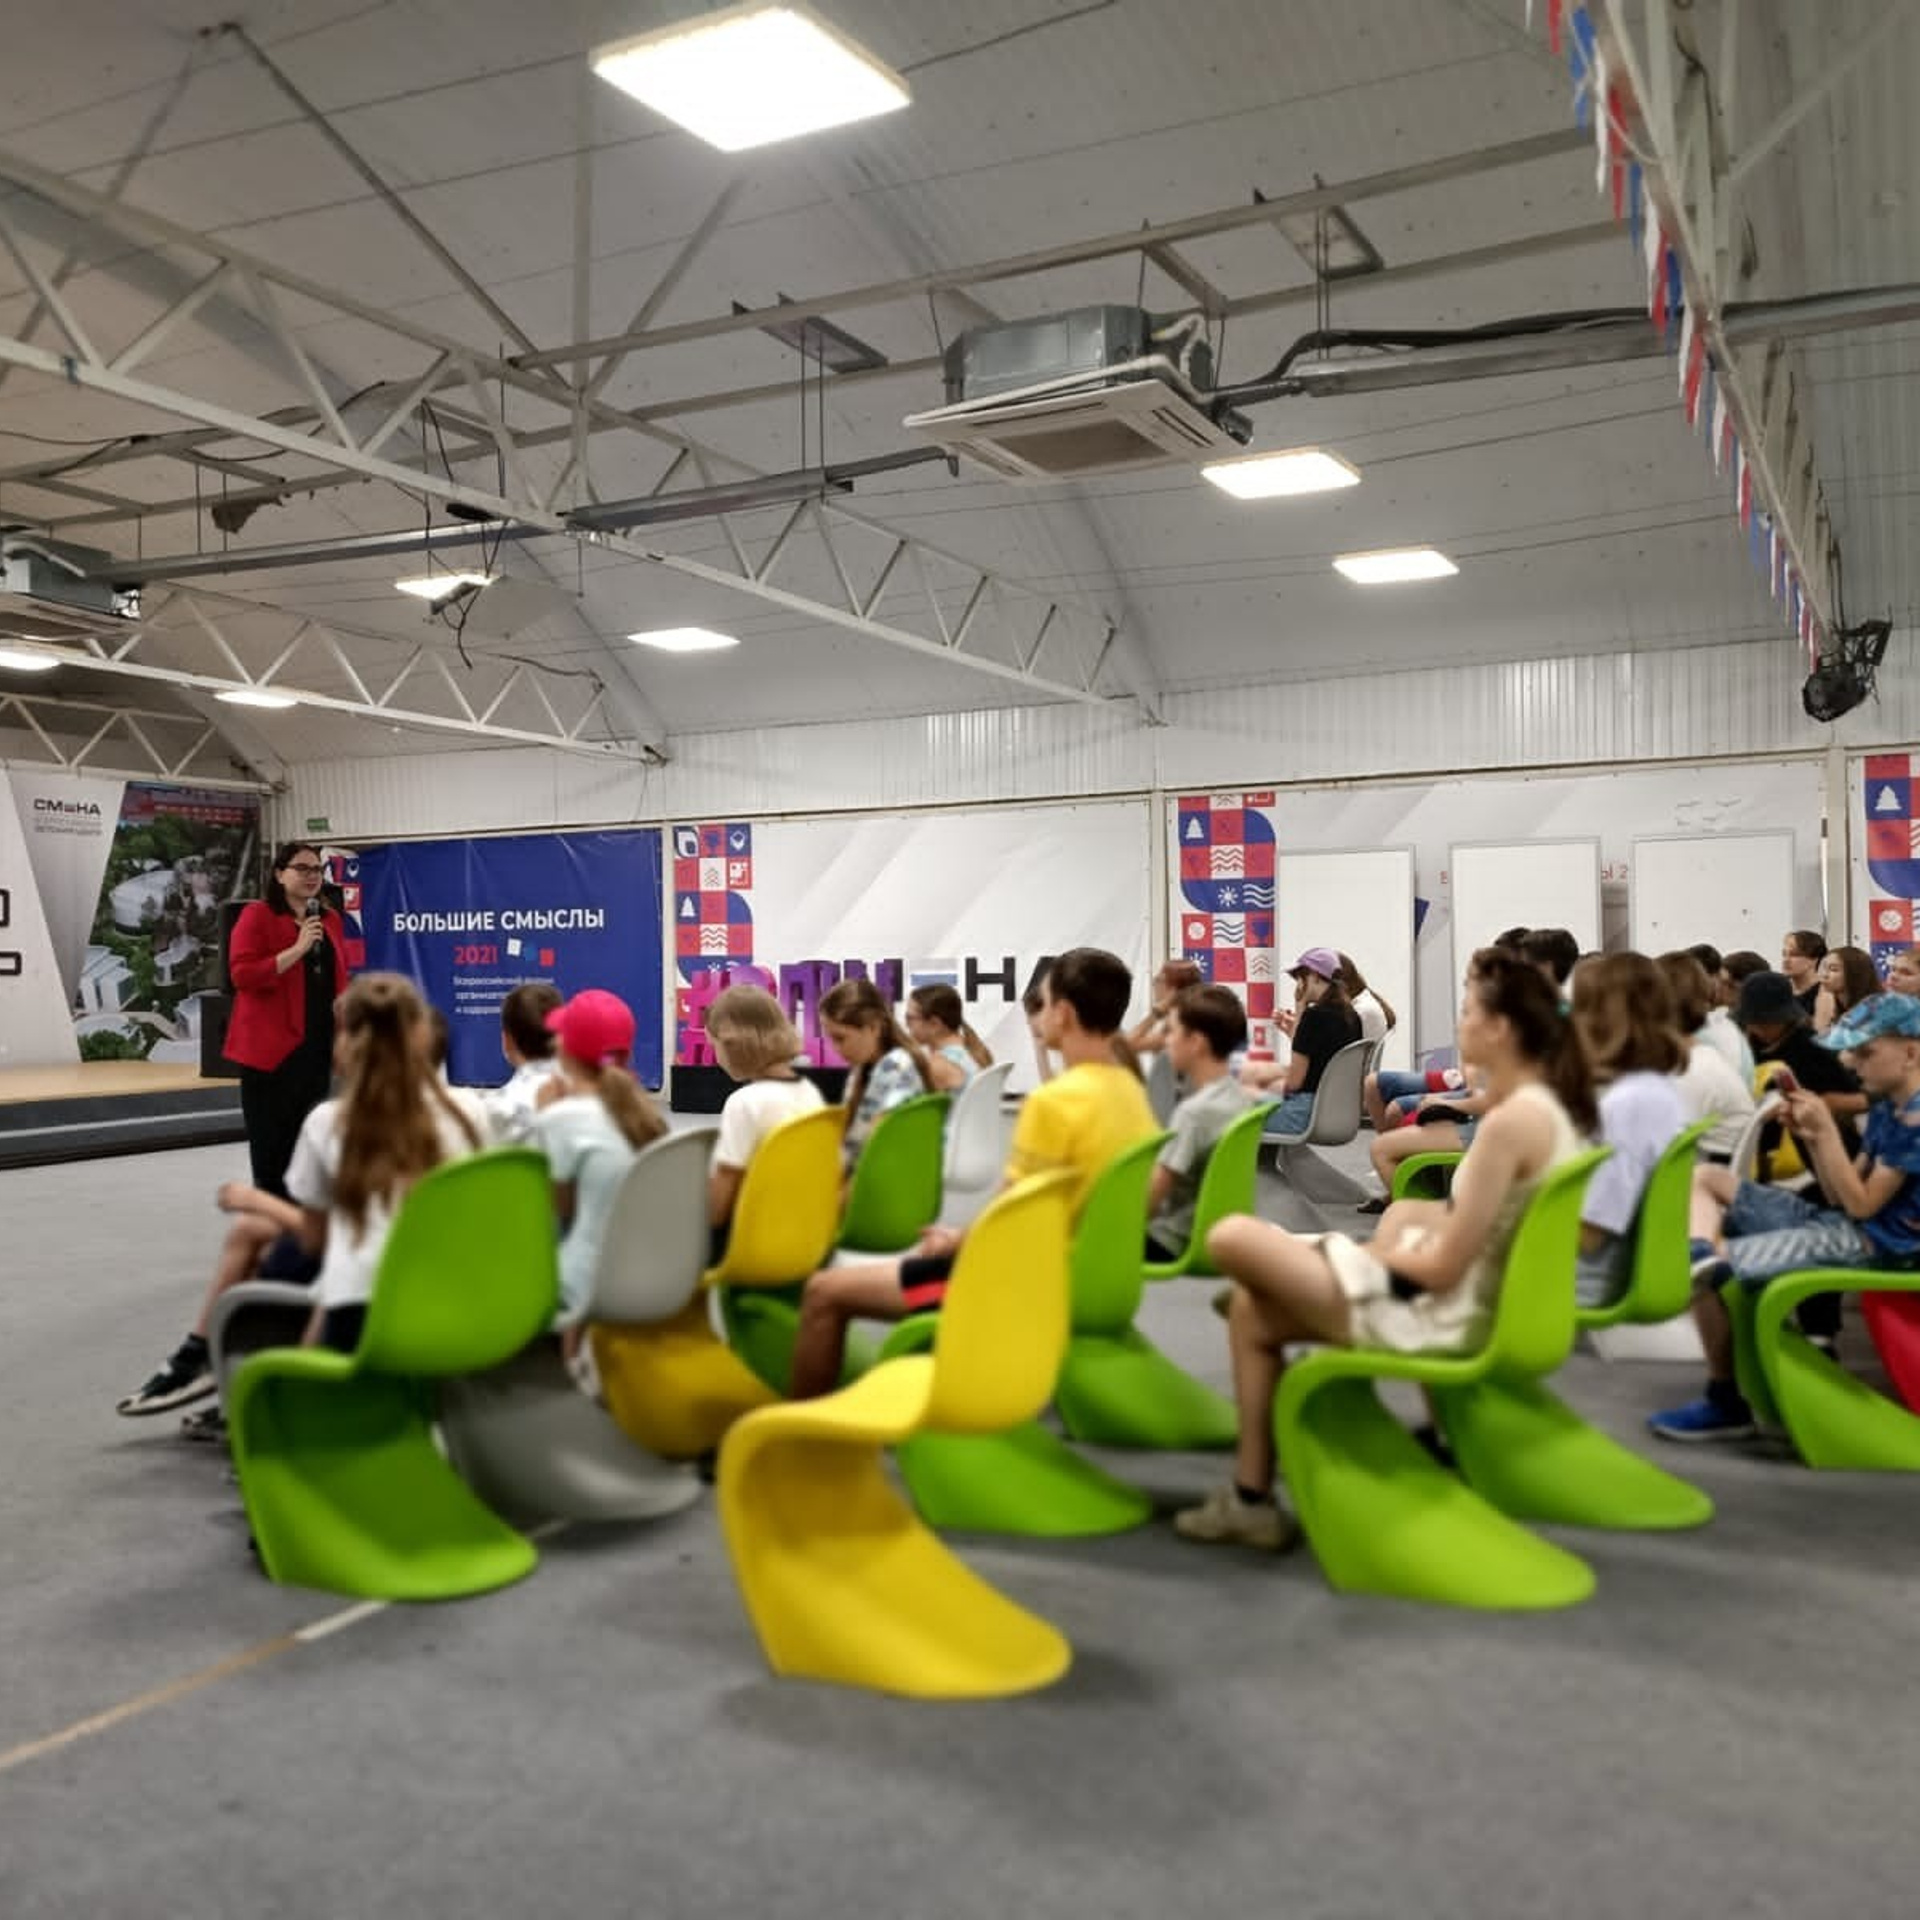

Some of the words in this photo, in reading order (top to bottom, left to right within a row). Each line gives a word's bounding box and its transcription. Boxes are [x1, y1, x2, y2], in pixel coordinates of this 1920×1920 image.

[393, 911, 496, 932] БОЛЬШИЕ
[500, 908, 605, 931] СМЫСЛЫ
[453, 944, 498, 965] 2021
